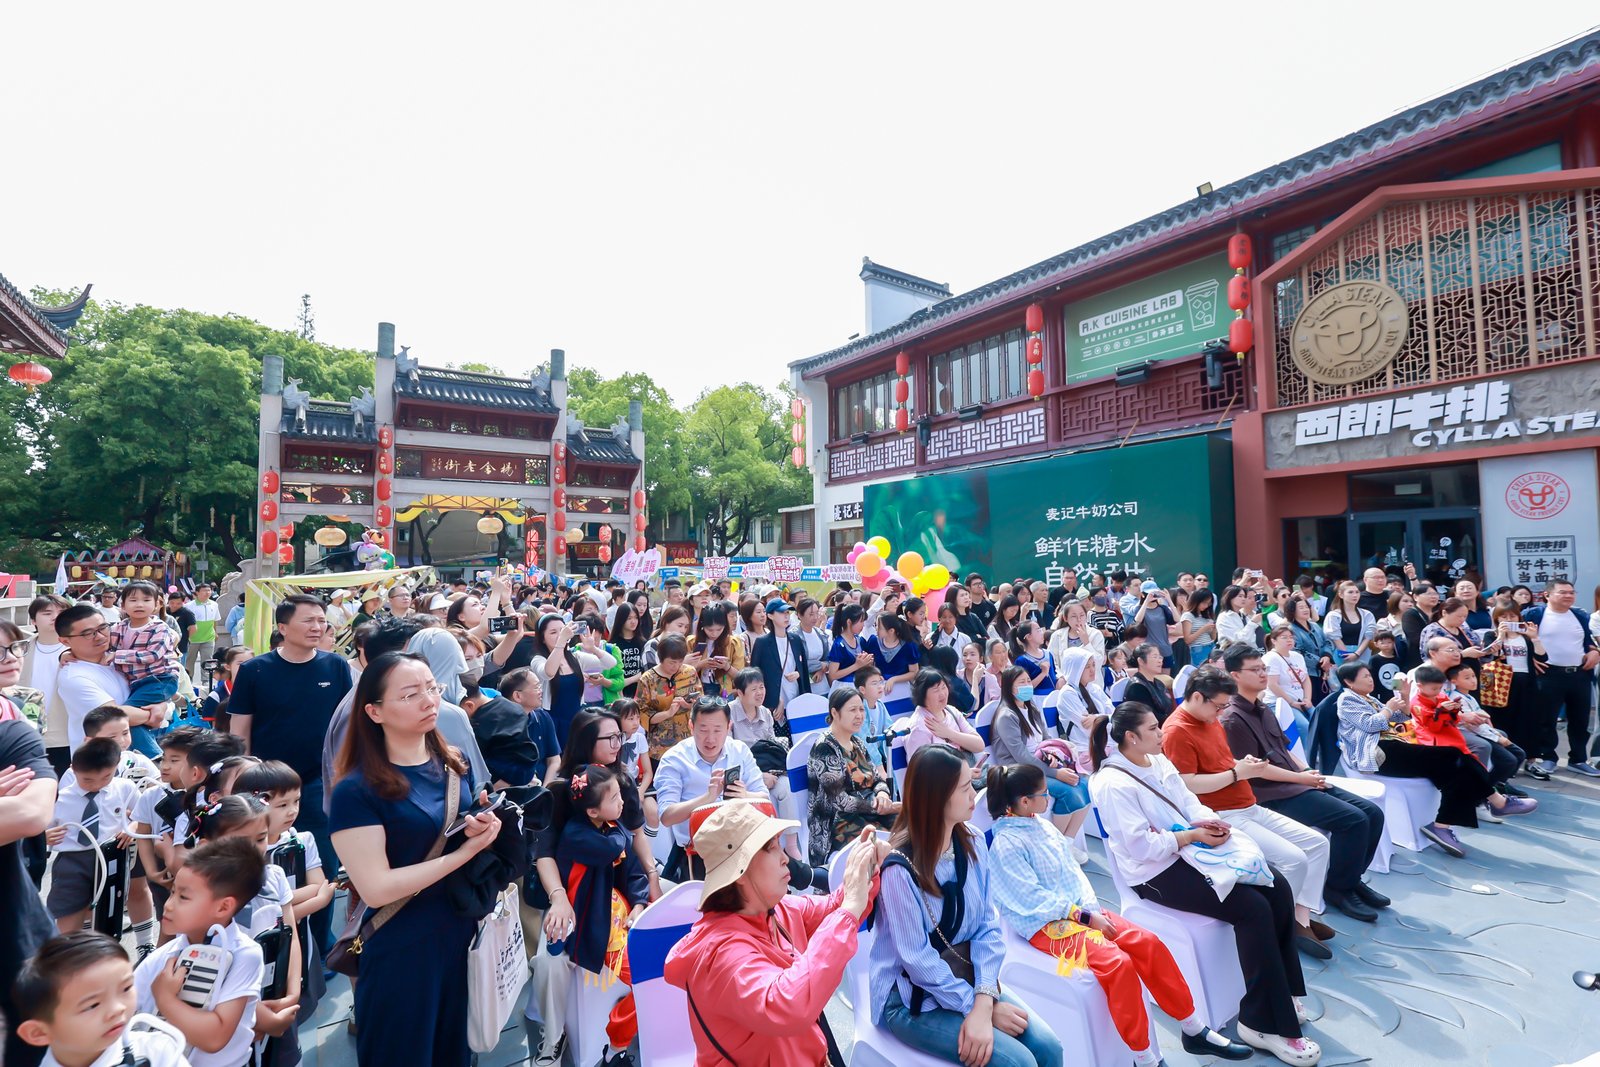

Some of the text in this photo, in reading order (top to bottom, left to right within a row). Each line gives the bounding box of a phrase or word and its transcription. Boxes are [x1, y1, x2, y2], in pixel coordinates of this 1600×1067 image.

[1082, 294, 1177, 334] A.K CUISINE LAB
[1295, 380, 1511, 446] 西朗牛排
[1412, 410, 1600, 447] CYLLA STE
[1536, 473, 1563, 487] STEAK
[1045, 501, 1138, 521] 麦记牛奶公司
[1034, 532, 1156, 558] 鲜作糖水
[1516, 558, 1568, 571] 好牛排
